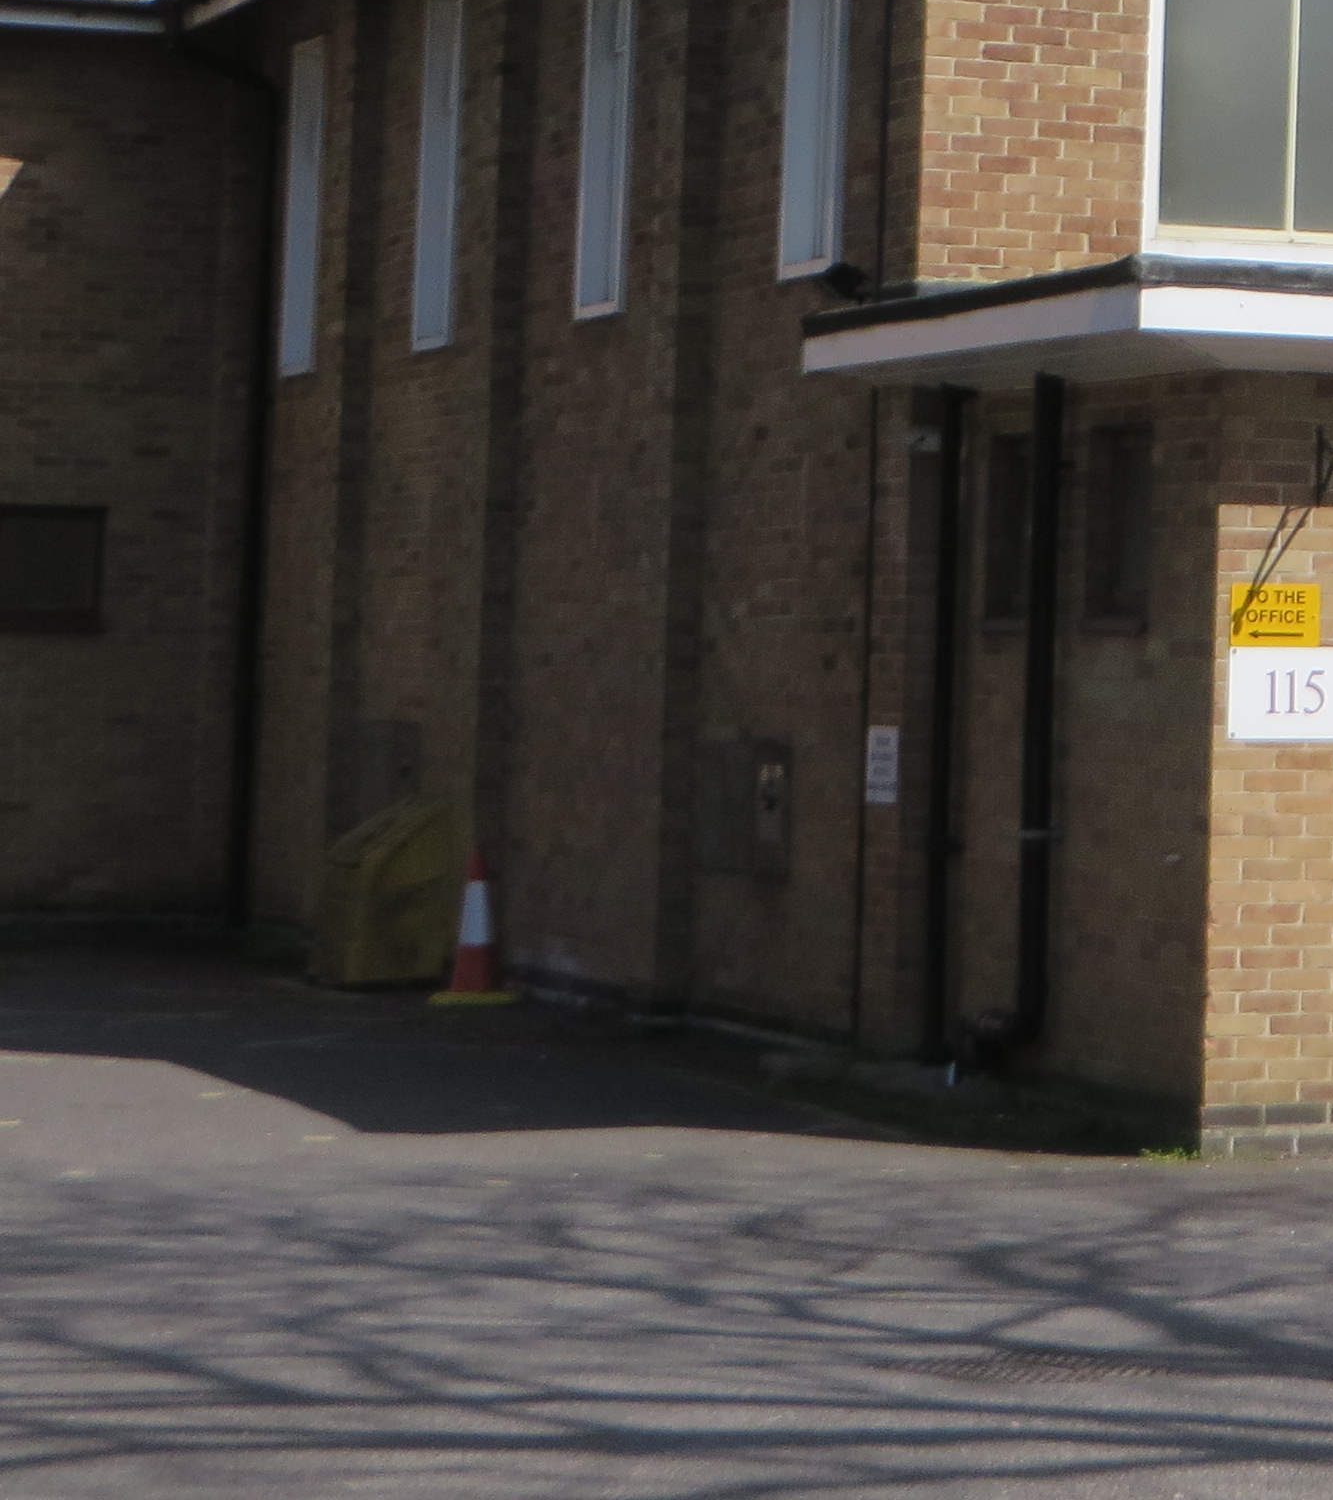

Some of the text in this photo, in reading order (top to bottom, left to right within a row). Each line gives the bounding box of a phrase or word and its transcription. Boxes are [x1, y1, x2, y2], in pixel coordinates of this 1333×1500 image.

[1247, 589, 1307, 604] TO THE
[1246, 609, 1306, 624] OFFICE
[1265, 668, 1326, 715] 115
